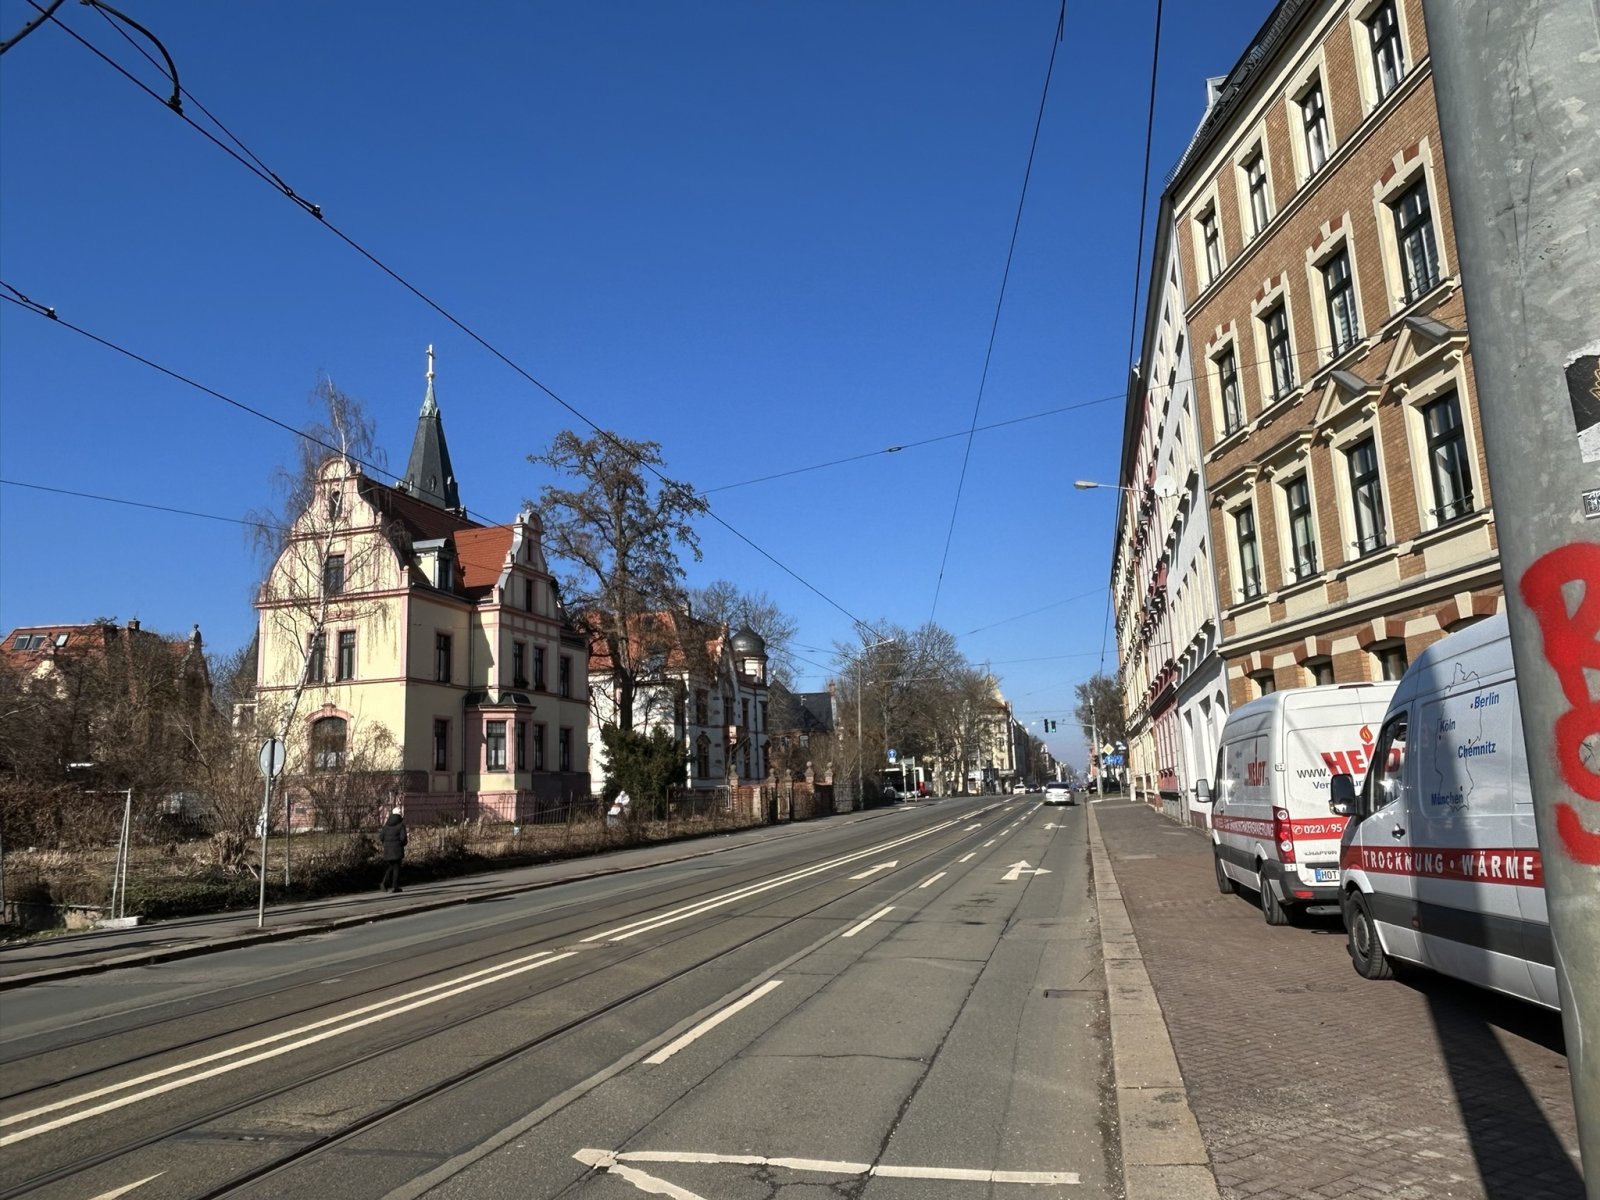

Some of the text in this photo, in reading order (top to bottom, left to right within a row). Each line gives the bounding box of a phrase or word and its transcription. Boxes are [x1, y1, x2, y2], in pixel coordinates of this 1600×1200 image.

[1474, 692, 1500, 709] Berlin
[1439, 718, 1456, 733] Köln
[1457, 741, 1496, 759] Chemnitz
[1431, 793, 1464, 806] München
[1363, 849, 1535, 881] TROCKNUNG WÄRME
